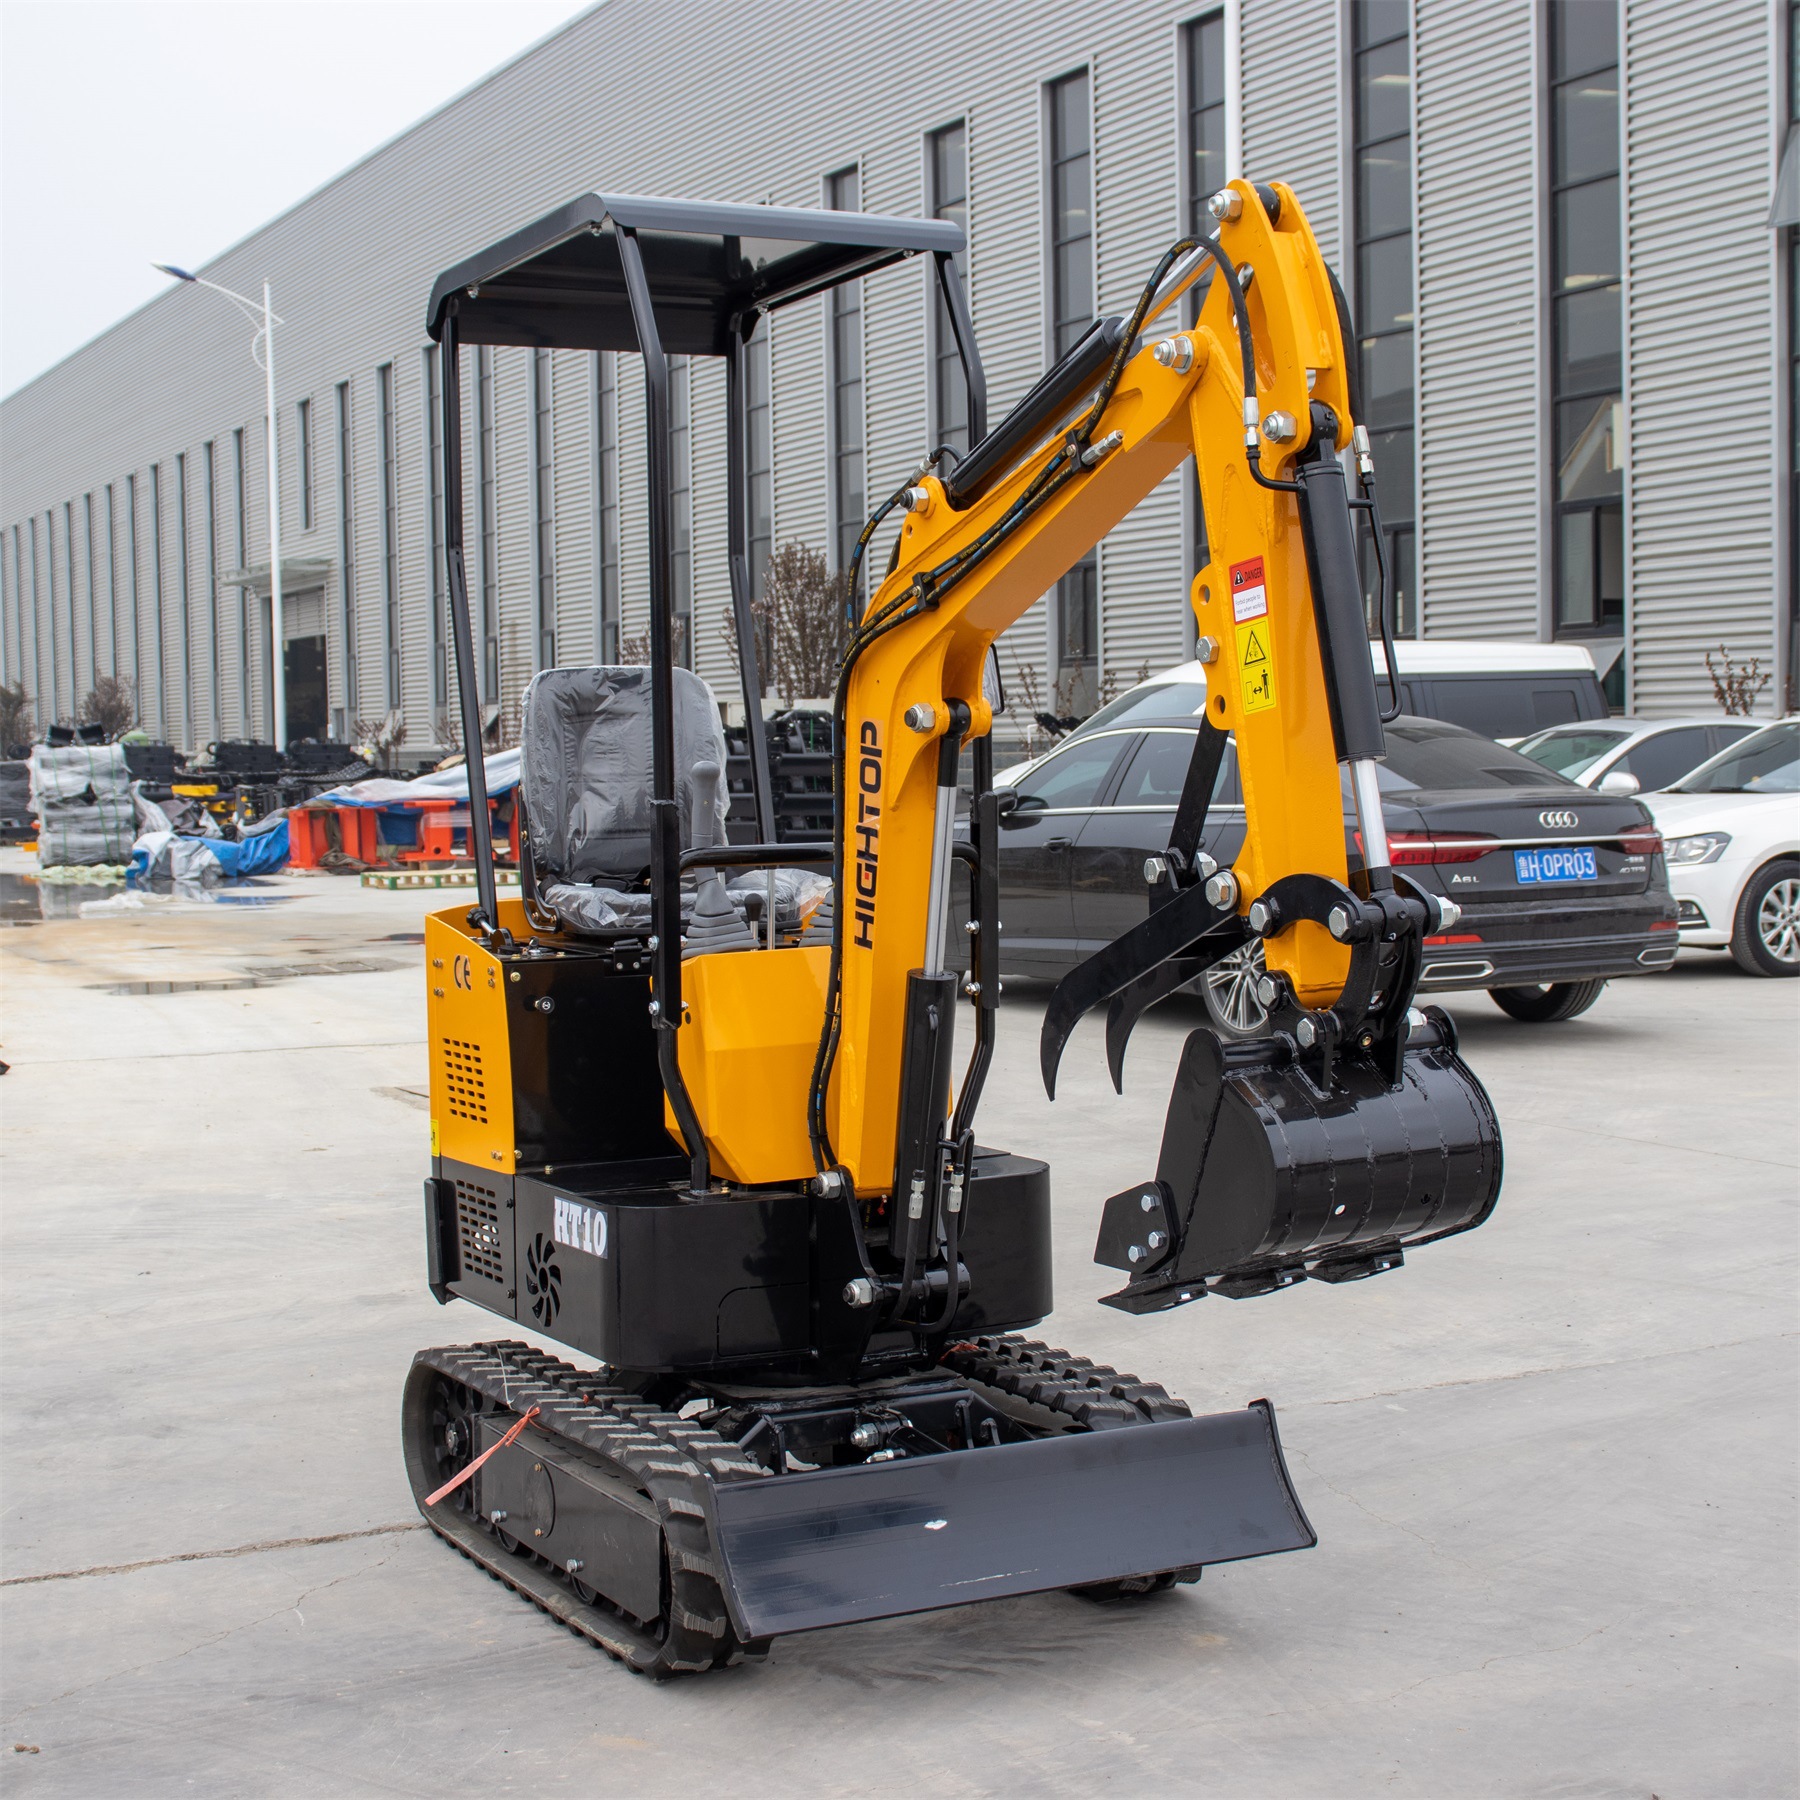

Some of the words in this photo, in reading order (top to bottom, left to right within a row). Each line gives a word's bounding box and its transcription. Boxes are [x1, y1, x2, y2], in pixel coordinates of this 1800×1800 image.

[1128, 320, 1136, 333] HOSE
[860, 520, 876, 543] YONGJIE
[1244, 566, 1263, 582] DANGER
[1246, 595, 1257, 604] people
[854, 721, 882, 950] HIGHTOP
[1451, 874, 1480, 883] A6L
[454, 954, 471, 991] CE
[554, 1198, 607, 1256] HT10
